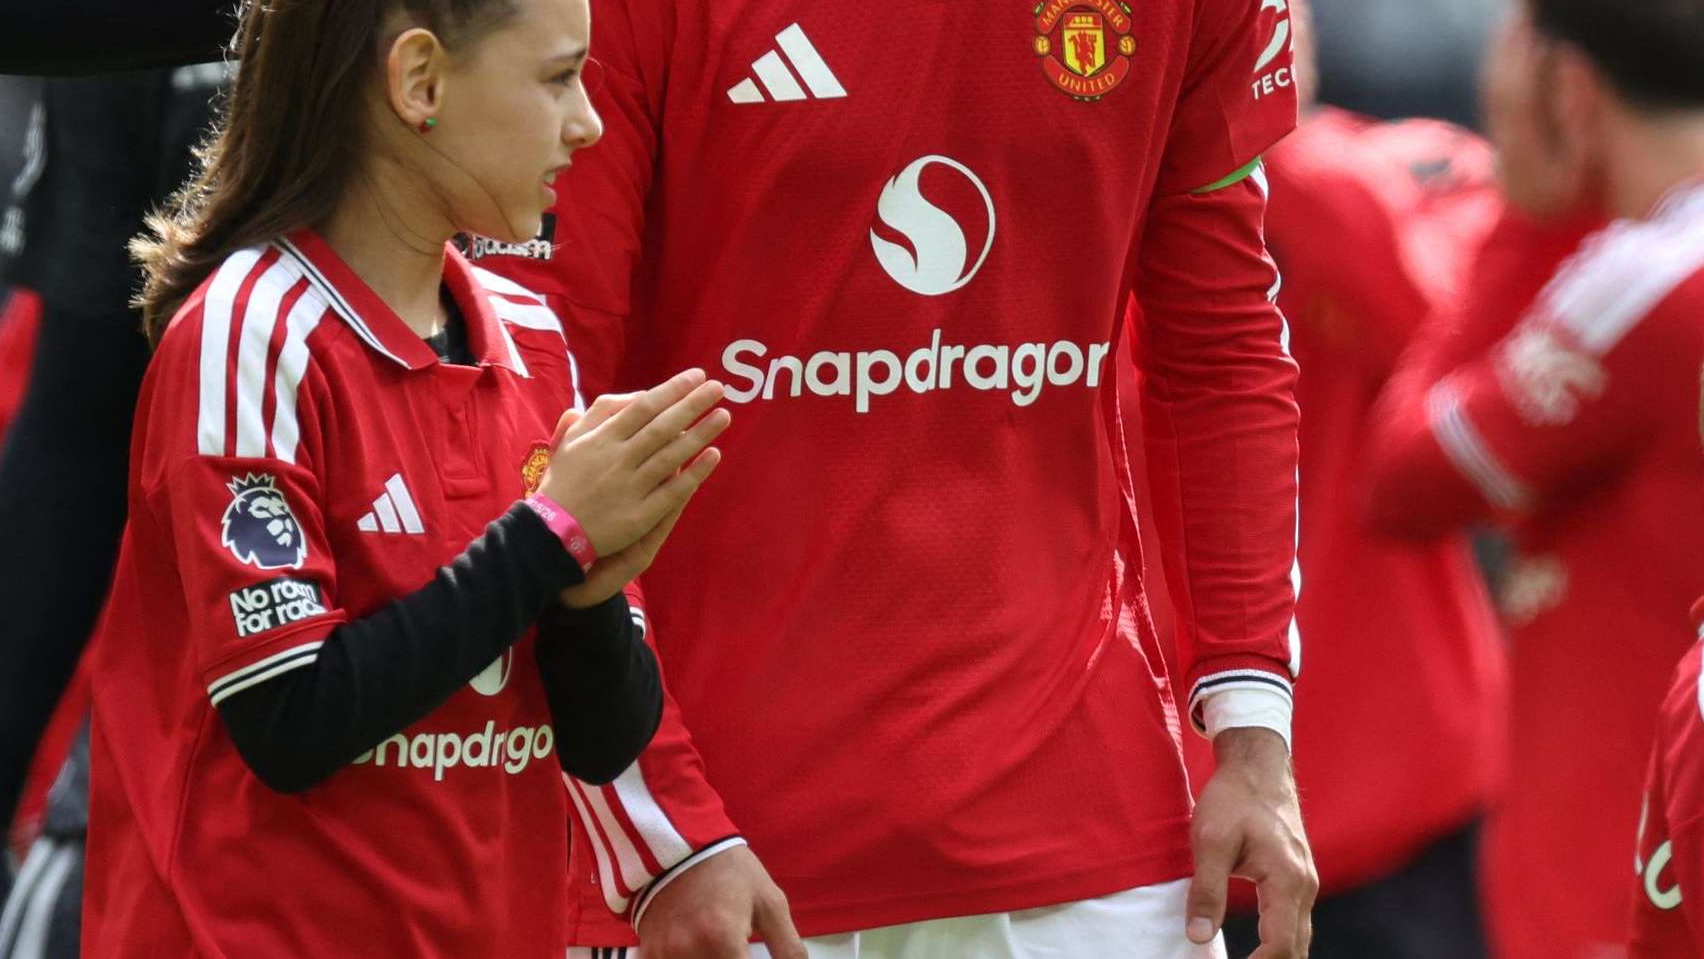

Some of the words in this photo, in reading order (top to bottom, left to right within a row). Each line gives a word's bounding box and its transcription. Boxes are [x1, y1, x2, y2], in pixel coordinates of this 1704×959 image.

[1058, 73, 1115, 92] UNITED
[229, 588, 269, 618] No
[236, 608, 273, 637] for
